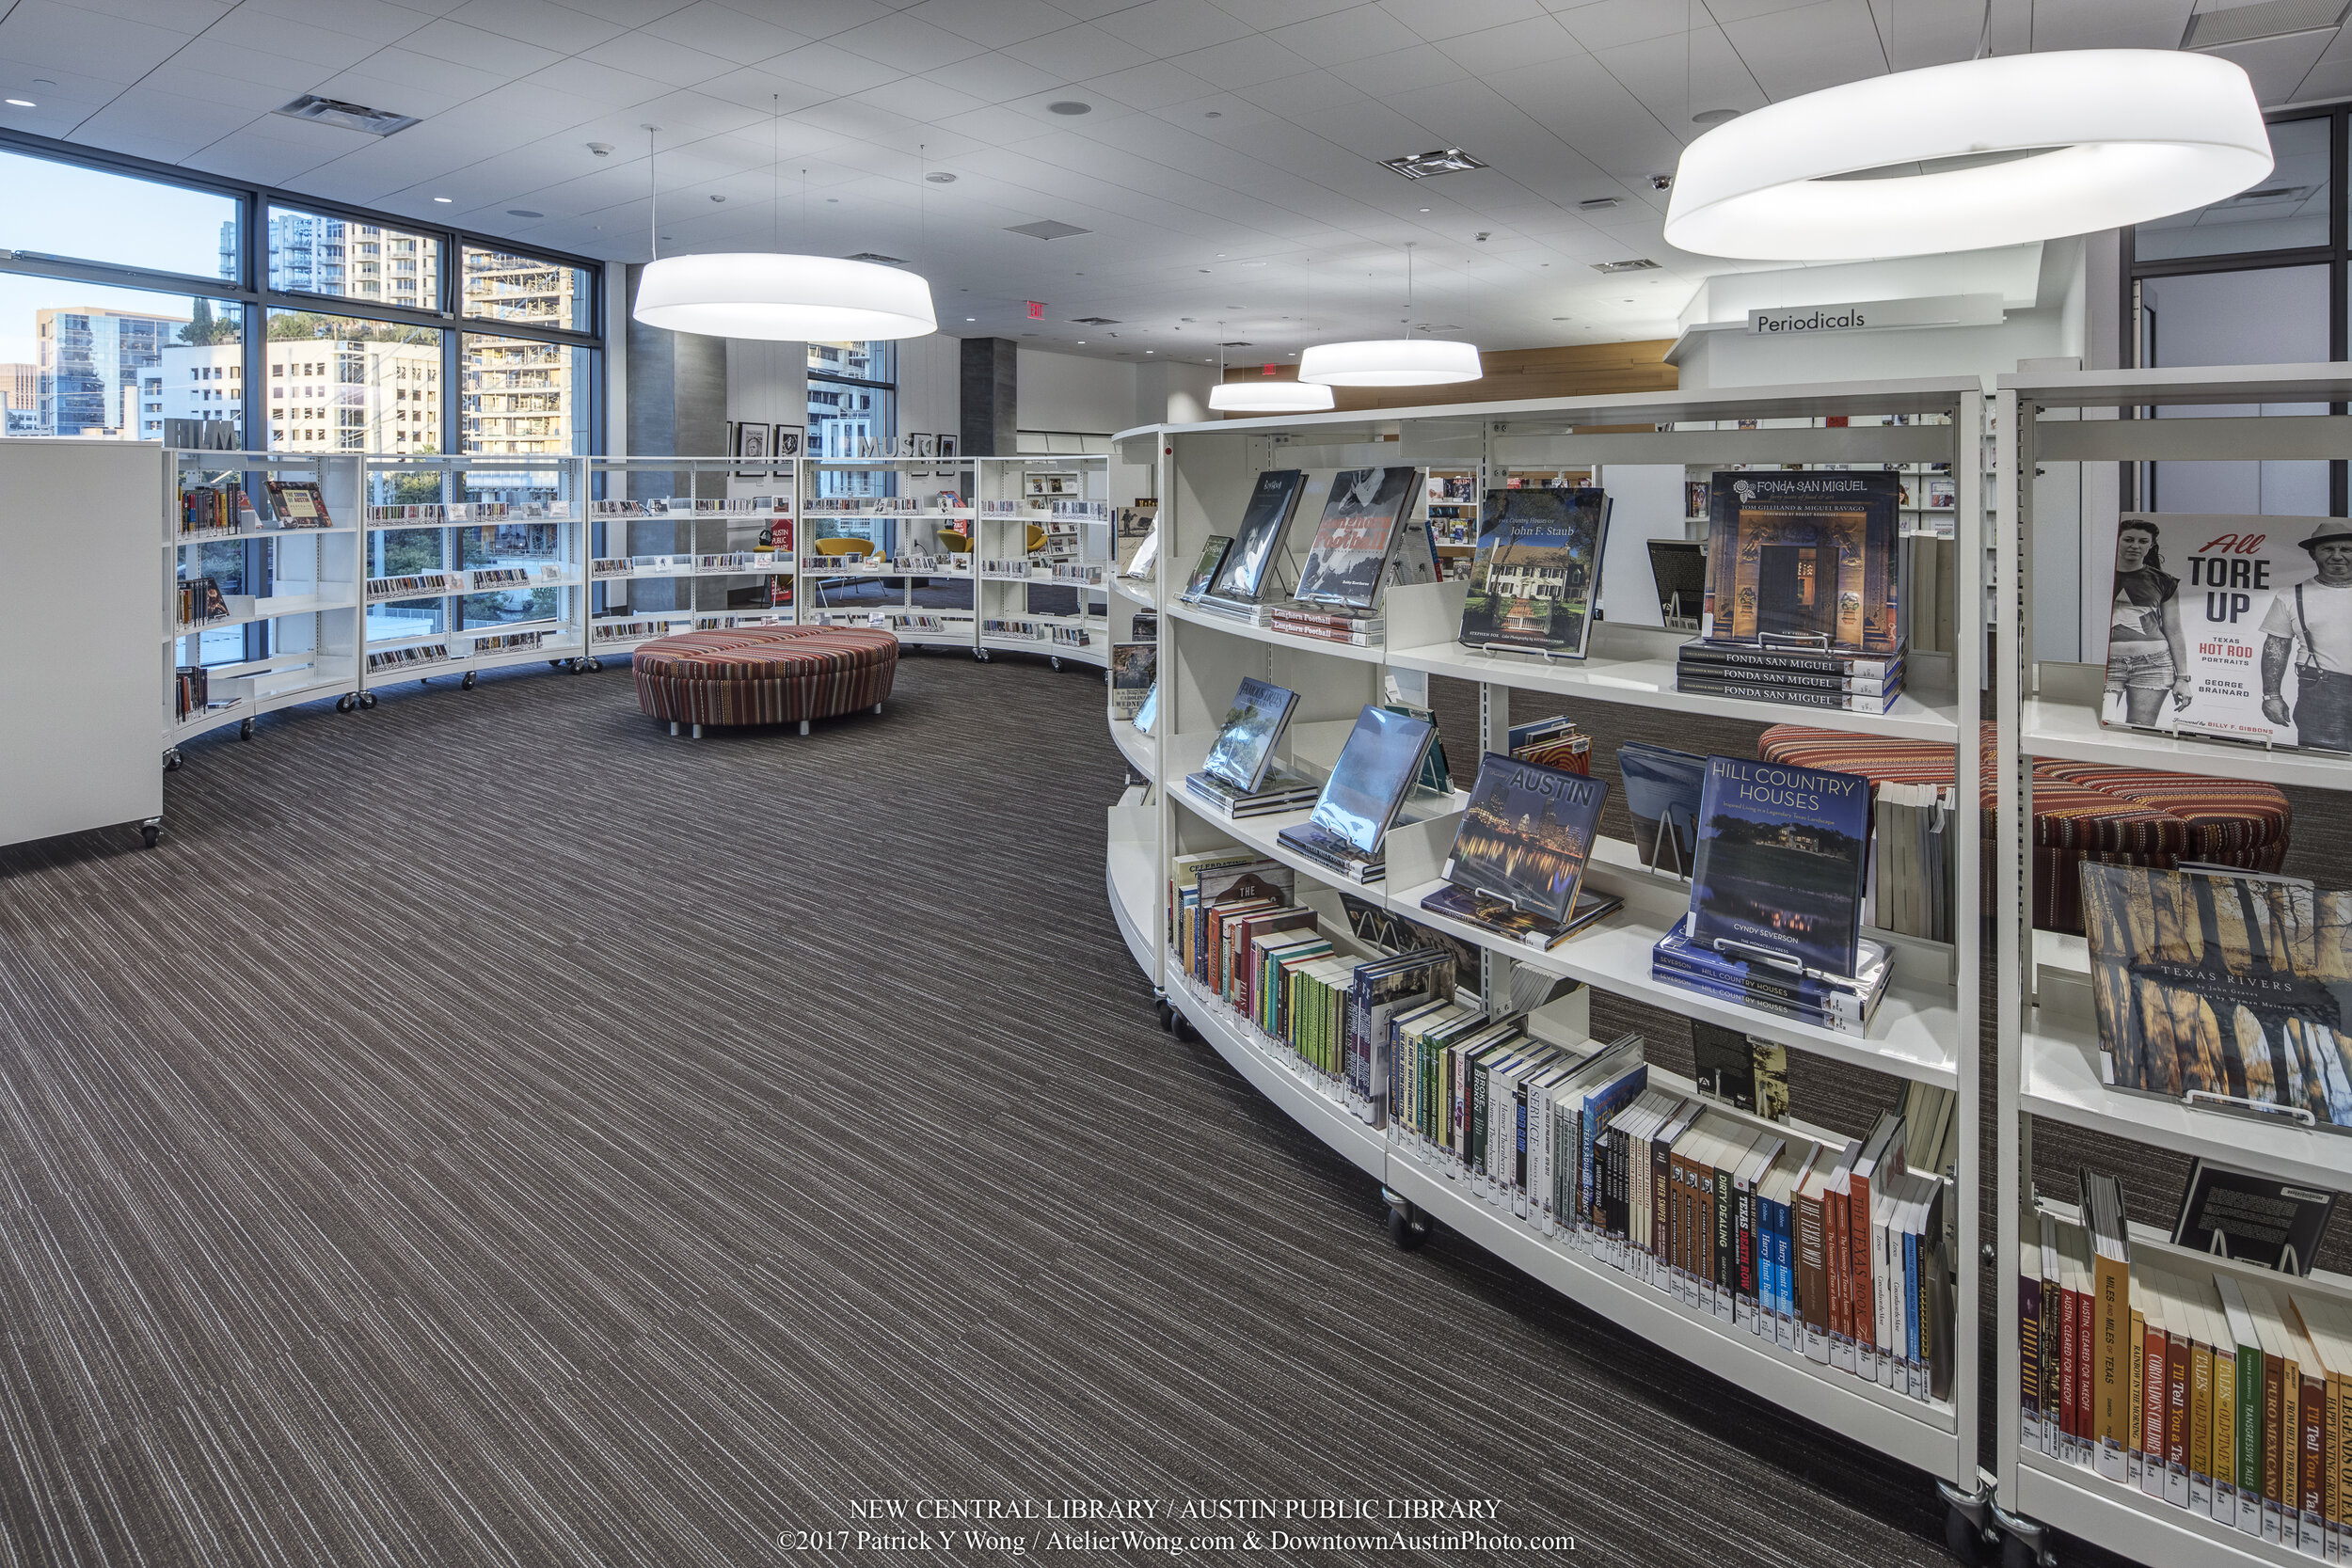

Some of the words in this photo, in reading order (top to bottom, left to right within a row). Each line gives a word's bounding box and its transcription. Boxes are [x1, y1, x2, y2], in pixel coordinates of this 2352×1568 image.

[1030, 303, 1042, 317] EXIT
[1757, 309, 1865, 333] Periodicals
[165, 418, 235, 451] FILM
[858, 436, 938, 458] MUSIC
[1797, 481, 1821, 492] SAN
[1822, 480, 1867, 493] MIGUEL
[1320, 515, 1392, 534] Longhorn
[1510, 526, 1534, 536] John
[1535, 526, 1544, 536] F.
[1547, 526, 1574, 536] Staub
[1314, 530, 1389, 550] Football
[2199, 533, 2266, 554] All
[2187, 557, 2270, 590] TORE
[1274, 608, 1303, 622] Longhorn
[1304, 613, 1331, 626] Football
[2206, 591, 2250, 624] UP
[1274, 621, 1303, 635] Longhorn
[1304, 626, 1331, 639] Football
[1726, 654, 1763, 666] FONDA
[1765, 657, 1788, 668] SAN
[1789, 659, 1835, 672] MIGUEL
[2199, 642, 2222, 656] HOT
[2227, 645, 2252, 658] ROD
[2201, 657, 2249, 666] PORTRAITS
[1724, 669, 1760, 681] FONDA
[1763, 673, 1785, 683] SAN
[1788, 675, 1833, 688] MIGUEL
[2204, 679, 2244, 689] GEORGE
[1238, 682, 1266, 699] FAMOUS
[1263, 689, 1282, 707] TREES
[2199, 687, 2249, 697] BRAINARD
[2238, 725, 2274, 735] GIBBONS
[1510, 768, 1594, 806] AUSTIN
[1712, 761, 1751, 782] HILL
[1755, 768, 1855, 797] COUNTRY
[1740, 784, 1820, 811] HOUSES
[1240, 885, 1255, 897] THE
[1733, 923, 1758, 938] CYNDY
[1759, 927, 1799, 944] SEVERSON
[1660, 955, 1692, 970] SEVERSON
[1701, 967, 1718, 977] HILL
[1718, 970, 1756, 989] COUNTRY
[1756, 981, 1788, 997] HOUSES
[2161, 965, 2217, 981] TEXAS
[2227, 974, 2293, 992] RIVERS
[1517, 1104, 1526, 1128] FADED
[1529, 1089, 1540, 1147] SERVICE
[1487, 1127, 1496, 1170] Thornberry
[1517, 1128, 1526, 1154] GLORY
[1657, 1174, 1666, 1199] TOWER
[1718, 1174, 1727, 1203] DIRTY
[1657, 1199, 1666, 1223] SNIPER
[1739, 1196, 1749, 1229] TEXAS
[1800, 1199, 1820, 1220] THE
[1853, 1196, 1865, 1223] THE
[1719, 1204, 1727, 1248] DEALING
[1800, 1217, 1821, 1249] TEXAS
[1740, 1229, 1749, 1263] DEATH
[1777, 1240, 1787, 1264] Harry
[1802, 1246, 1821, 1271] WAY
[1852, 1227, 1867, 1279] TEXAS
[1740, 1265, 1750, 1291] ROW
[1779, 1264, 1788, 1288] Huntt
[2106, 1275, 2115, 1303] MILES
[1855, 1281, 1867, 1318] BOOK
[2063, 1294, 2072, 1323] AUSTIN,
[2063, 1324, 2072, 1355] CLEARED
[2105, 1317, 2115, 1344] MILES
[2106, 1345, 2113, 1354] OF
[2132, 1344, 2141, 1380] RAINBOW
[2063, 1357, 2072, 1372] FOR
[2105, 1354, 2115, 1385] TEXAS
[2063, 1374, 2073, 1406] TAKEOFF
[2132, 1380, 2140, 1389] IN
[2147, 1354, 2163, 1411] CORONADO'S
[2218, 1363, 2233, 1402] TALES
[2132, 1389, 2140, 1404] THE
[2266, 1379, 2279, 1420] PURO
[2131, 1404, 2140, 1439] MORNING
[2286, 1399, 2296, 1424] FROM
[2307, 1404, 2320, 1423] I'll
[2326, 1397, 2337, 1429] HAPPY
[2217, 1407, 2232, 1463] OLD-TIME
[2245, 1403, 2254, 1464] TRANSGRESSIVE
[2286, 1424, 2296, 1449] HELL
[2306, 1425, 2320, 1451] Tell
[2342, 1394, 2352, 1465] LEGENDS
[2265, 1421, 2278, 1497] MEXICANO
[2286, 1449, 2296, 1461] TO
[2326, 1430, 2337, 1474] HUNTING
[2245, 1465, 2254, 1487] TALES
[2306, 1453, 2319, 1479] You
[2342, 1468, 2352, 1487] OF
[2285, 1461, 2296, 1507] BREAKFAST
[2306, 1480, 2316, 1490] a
[2326, 1475, 2337, 1516] GROUND
[2306, 1491, 2319, 1514] Tal
[2342, 1491, 2352, 1527] TEX
